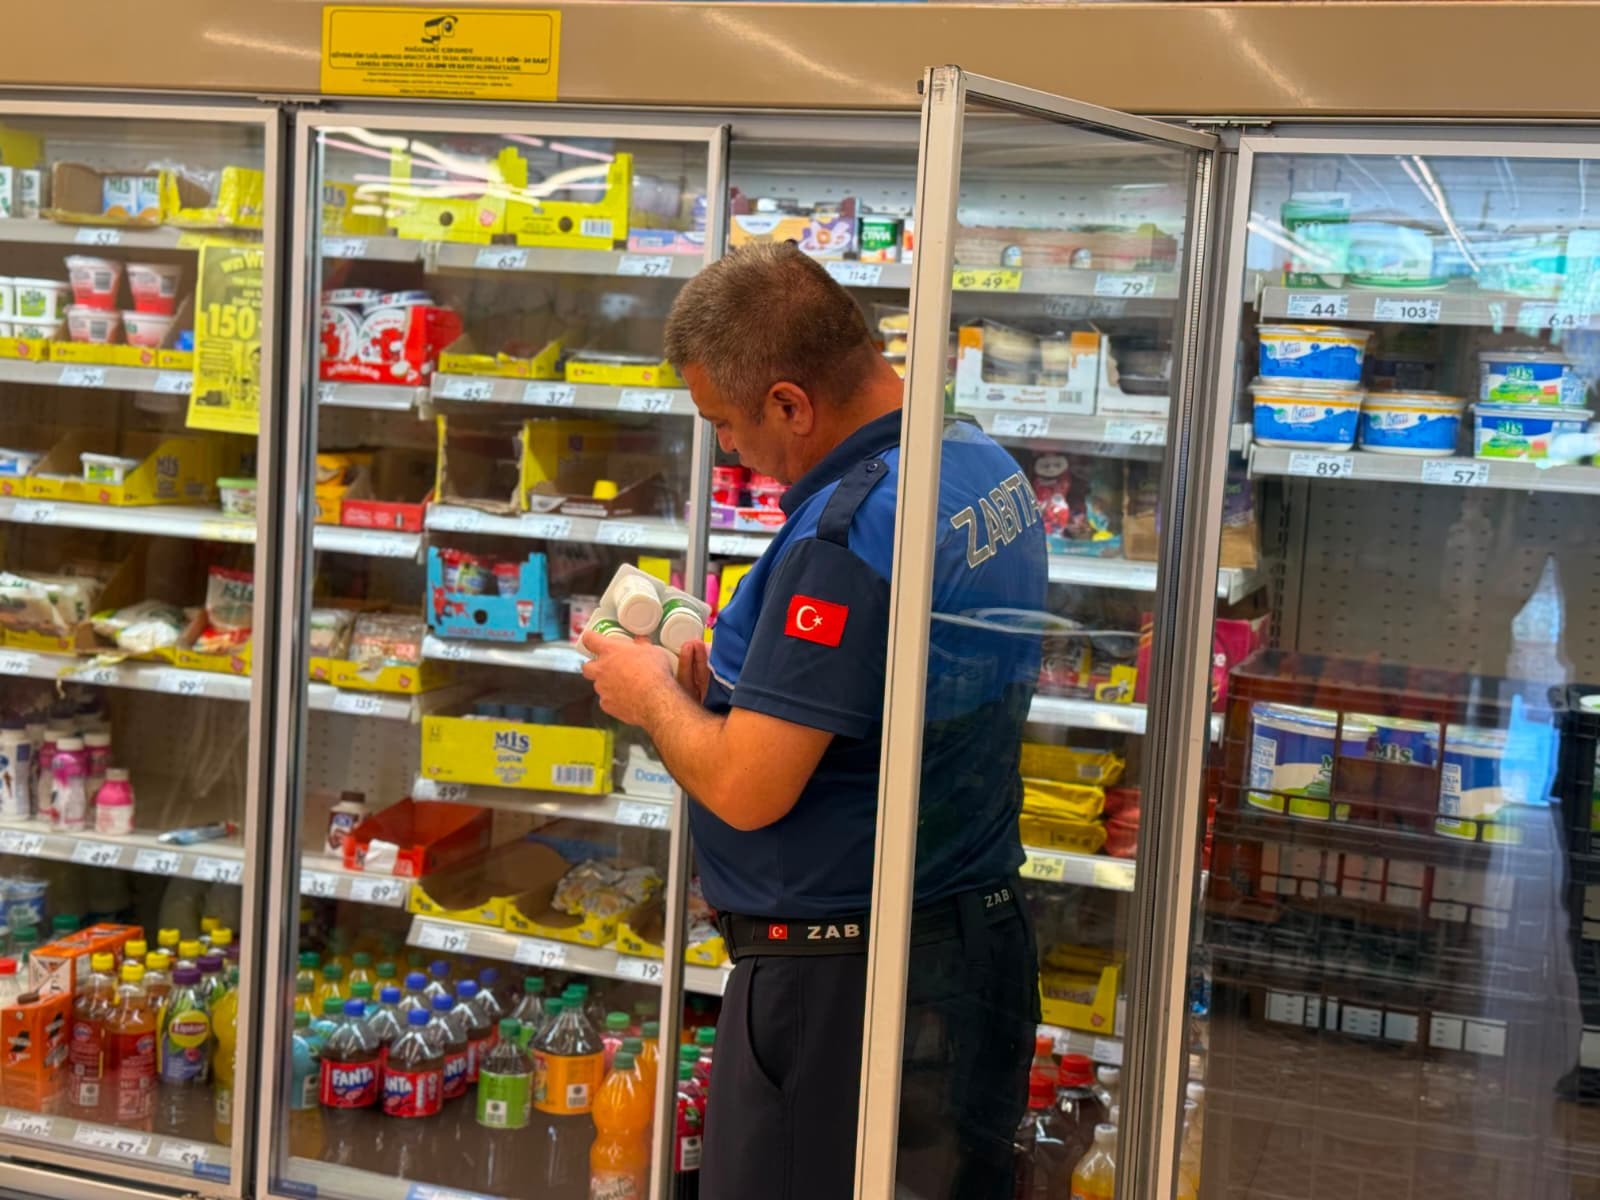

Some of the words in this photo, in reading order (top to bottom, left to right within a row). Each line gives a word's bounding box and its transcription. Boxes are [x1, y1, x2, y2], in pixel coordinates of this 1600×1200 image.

[497, 255, 518, 268] 62
[642, 263, 662, 276] 57
[1121, 281, 1143, 295] 79
[1310, 303, 1336, 317] 44
[1400, 306, 1427, 319] 103
[207, 303, 256, 341] 150
[1548, 314, 1575, 328] 64
[545, 391, 567, 404] 37
[642, 398, 663, 412] 37
[1015, 422, 1038, 436] 47
[1129, 430, 1153, 444] 47
[1315, 461, 1341, 476] 89
[1452, 470, 1477, 485] 57
[437, 784, 458, 800] 49
[639, 812, 658, 826] 87
[371, 885, 391, 900] 89
[984, 888, 1010, 908] ZAB
[807, 923, 861, 940] ZAB
[442, 934, 459, 948] 19
[641, 963, 659, 978] 19
